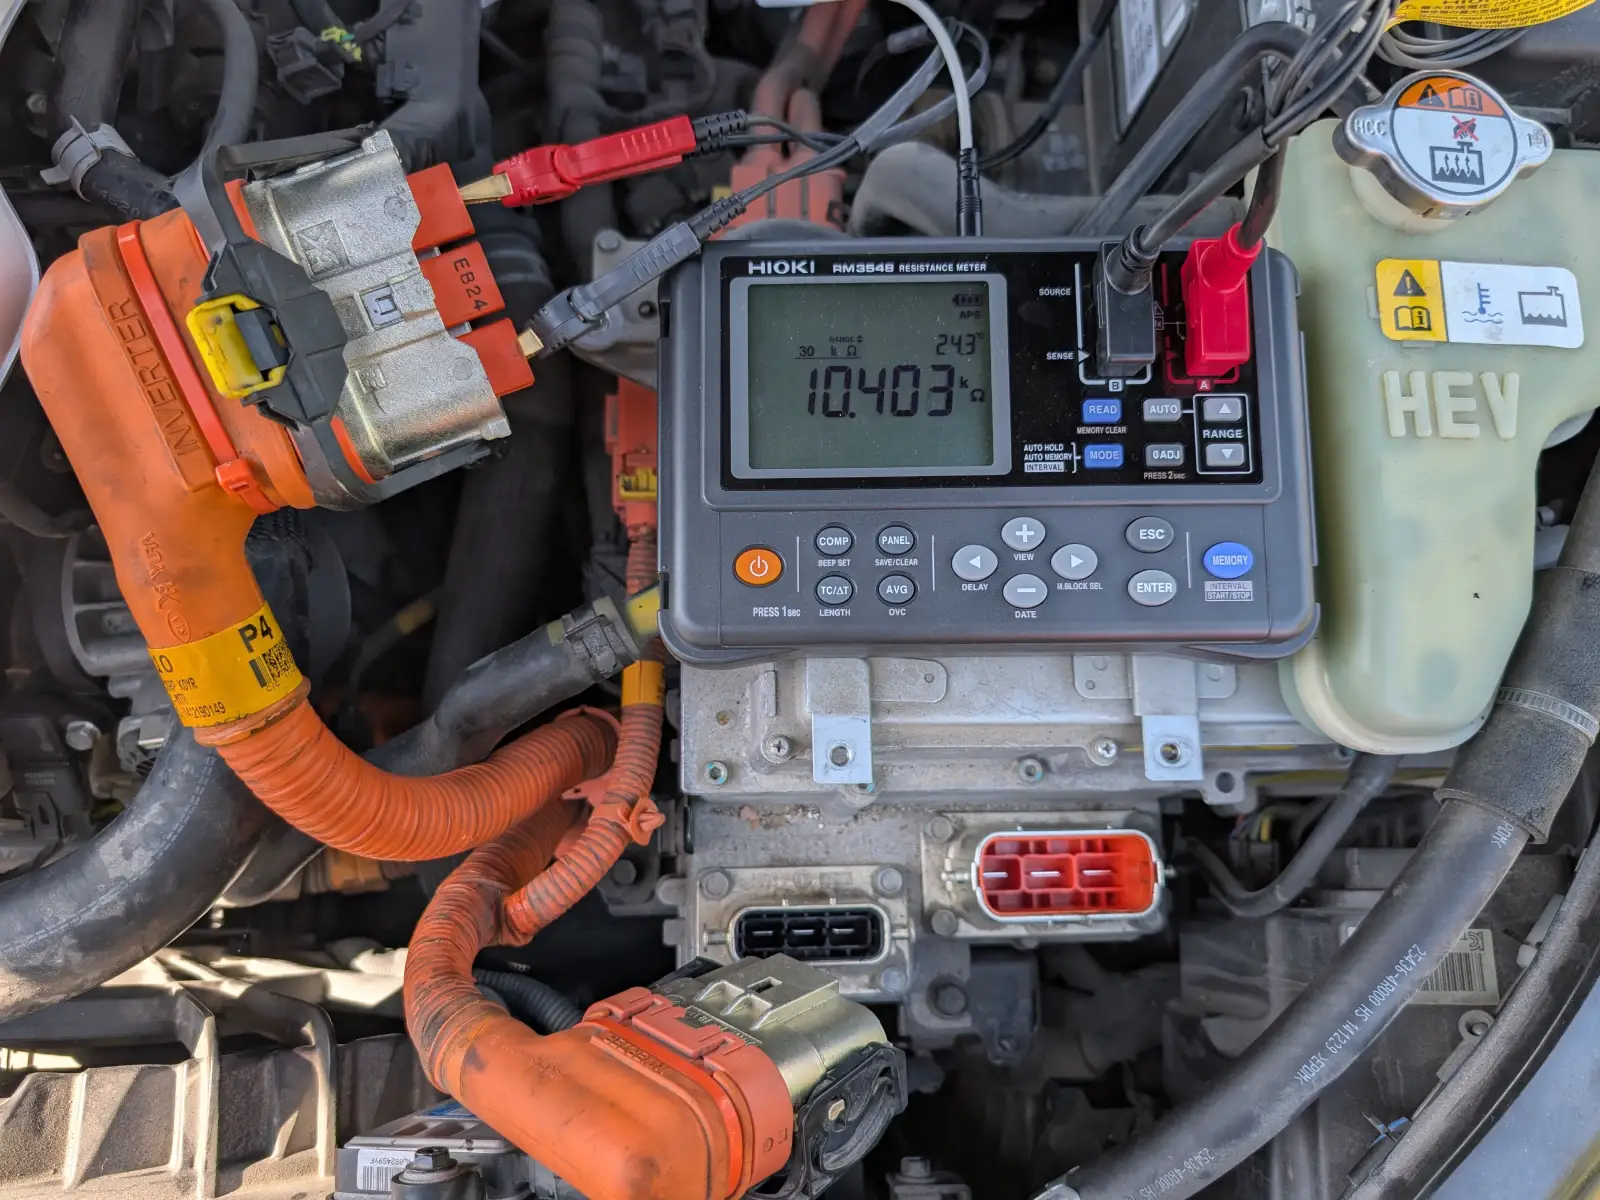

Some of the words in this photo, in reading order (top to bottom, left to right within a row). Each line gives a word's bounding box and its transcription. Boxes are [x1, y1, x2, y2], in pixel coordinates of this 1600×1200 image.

[1354, 118, 1387, 136] HCC
[748, 260, 815, 275] HIOKI
[832, 263, 894, 273] RM3548
[899, 264, 953, 273] RESISTANCE
[956, 263, 987, 272] METER
[1038, 288, 1072, 296] SOURCE
[959, 311, 982, 320] APS
[829, 336, 856, 344] RANGE
[799, 346, 815, 357] 30
[1046, 352, 1074, 360] SENSE
[108, 298, 201, 456] INVERTER
[1111, 381, 1120, 390] B
[1200, 381, 1209, 390] A
[807, 365, 956, 418] 10.403
[1149, 405, 1179, 414] AUTO
[1383, 370, 1520, 440] HEV
[1088, 405, 1118, 415] READ
[1076, 426, 1105, 435] MEMORY
[1105, 426, 1127, 434] CLEAR
[1202, 429, 1244, 439] RANGE
[1023, 443, 1042, 452] AUTO
[1044, 443, 1064, 451] HOLD
[1023, 453, 1043, 461] AUTO
[1044, 453, 1073, 461] MEMORY
[1089, 451, 1120, 460] MODE
[1026, 463, 1063, 471] INTERVAL
[1143, 472, 1167, 480] PRESS
[1139, 528, 1166, 540] ESC
[819, 536, 849, 546] COMP
[881, 535, 911, 545] PANEL
[1013, 553, 1035, 561] VIEW
[1211, 554, 1248, 566] MEMORY
[818, 559, 836, 567] BEEP
[837, 559, 851, 567] SET
[875, 558, 918, 566] SAVE/CLEAR
[886, 585, 908, 594] AVG
[961, 583, 988, 591] DELAY
[1056, 582, 1088, 590] M.BLOCK
[1089, 582, 1103, 590] SEL
[1136, 582, 1173, 593] ENTER
[1207, 591, 1251, 599] START/STOP
[753, 607, 780, 617] PRESS
[819, 608, 851, 617] LENGTH
[888, 608, 907, 616] OVC
[1014, 610, 1037, 619] DATE
[238, 614, 274, 654] P4
[1355, 1003, 1374, 1022] HS
